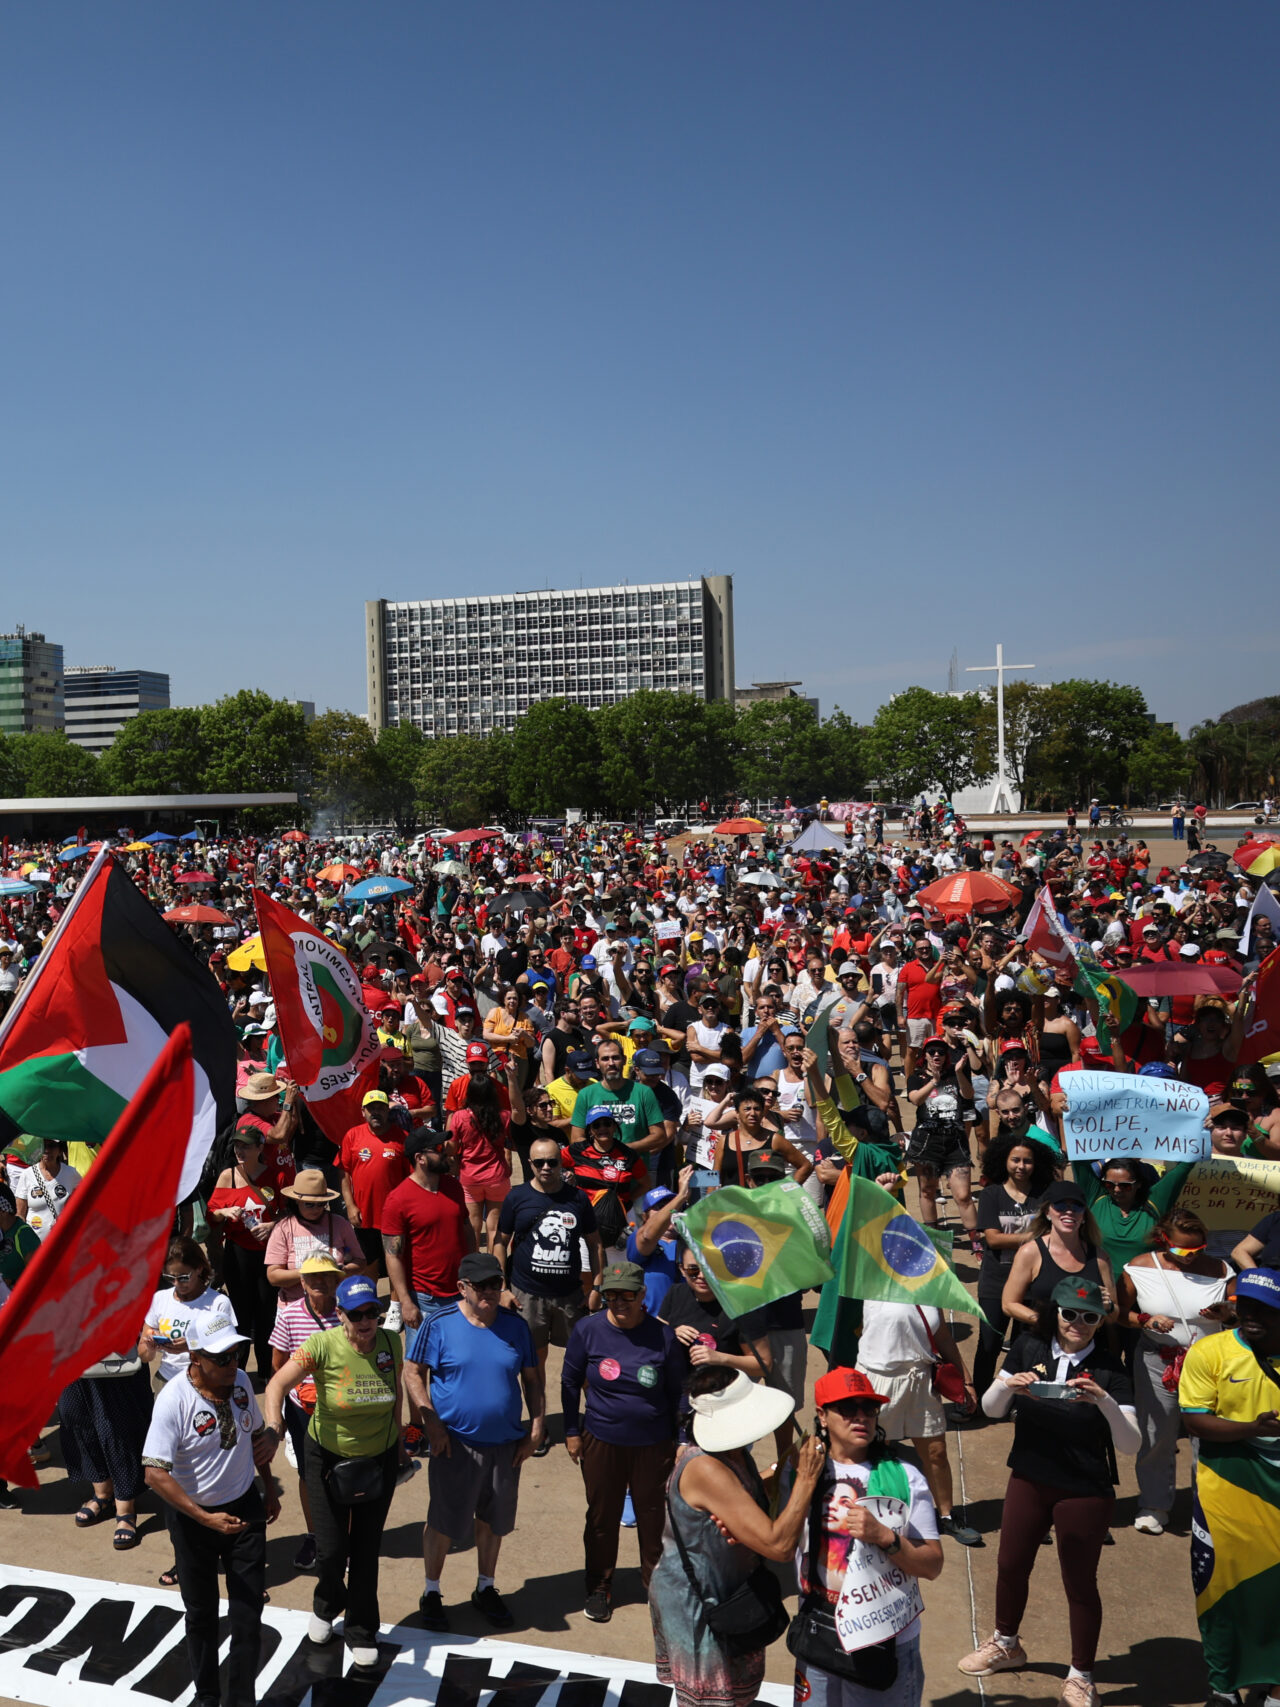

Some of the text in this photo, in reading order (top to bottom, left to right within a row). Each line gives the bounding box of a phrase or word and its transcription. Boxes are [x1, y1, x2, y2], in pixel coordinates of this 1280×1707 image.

[1070, 1115, 1149, 1134] GOLPE,
[1075, 1136, 1143, 1155] NUNCA
[1182, 1182, 1200, 1196] ÃO
[1209, 1185, 1240, 1196] AOS
[1208, 1199, 1225, 1208] DA
[800, 1196, 829, 1249] SOBERANO
[800, 1207, 820, 1241] BRASIL
[532, 1265, 570, 1275] PRESIDENTE
[1247, 1273, 1275, 1285] BRASIL
[1241, 1277, 1280, 1292] SOBERANO
[850, 1579, 883, 1606] SEM
[838, 1608, 895, 1638] CONGRESSO
